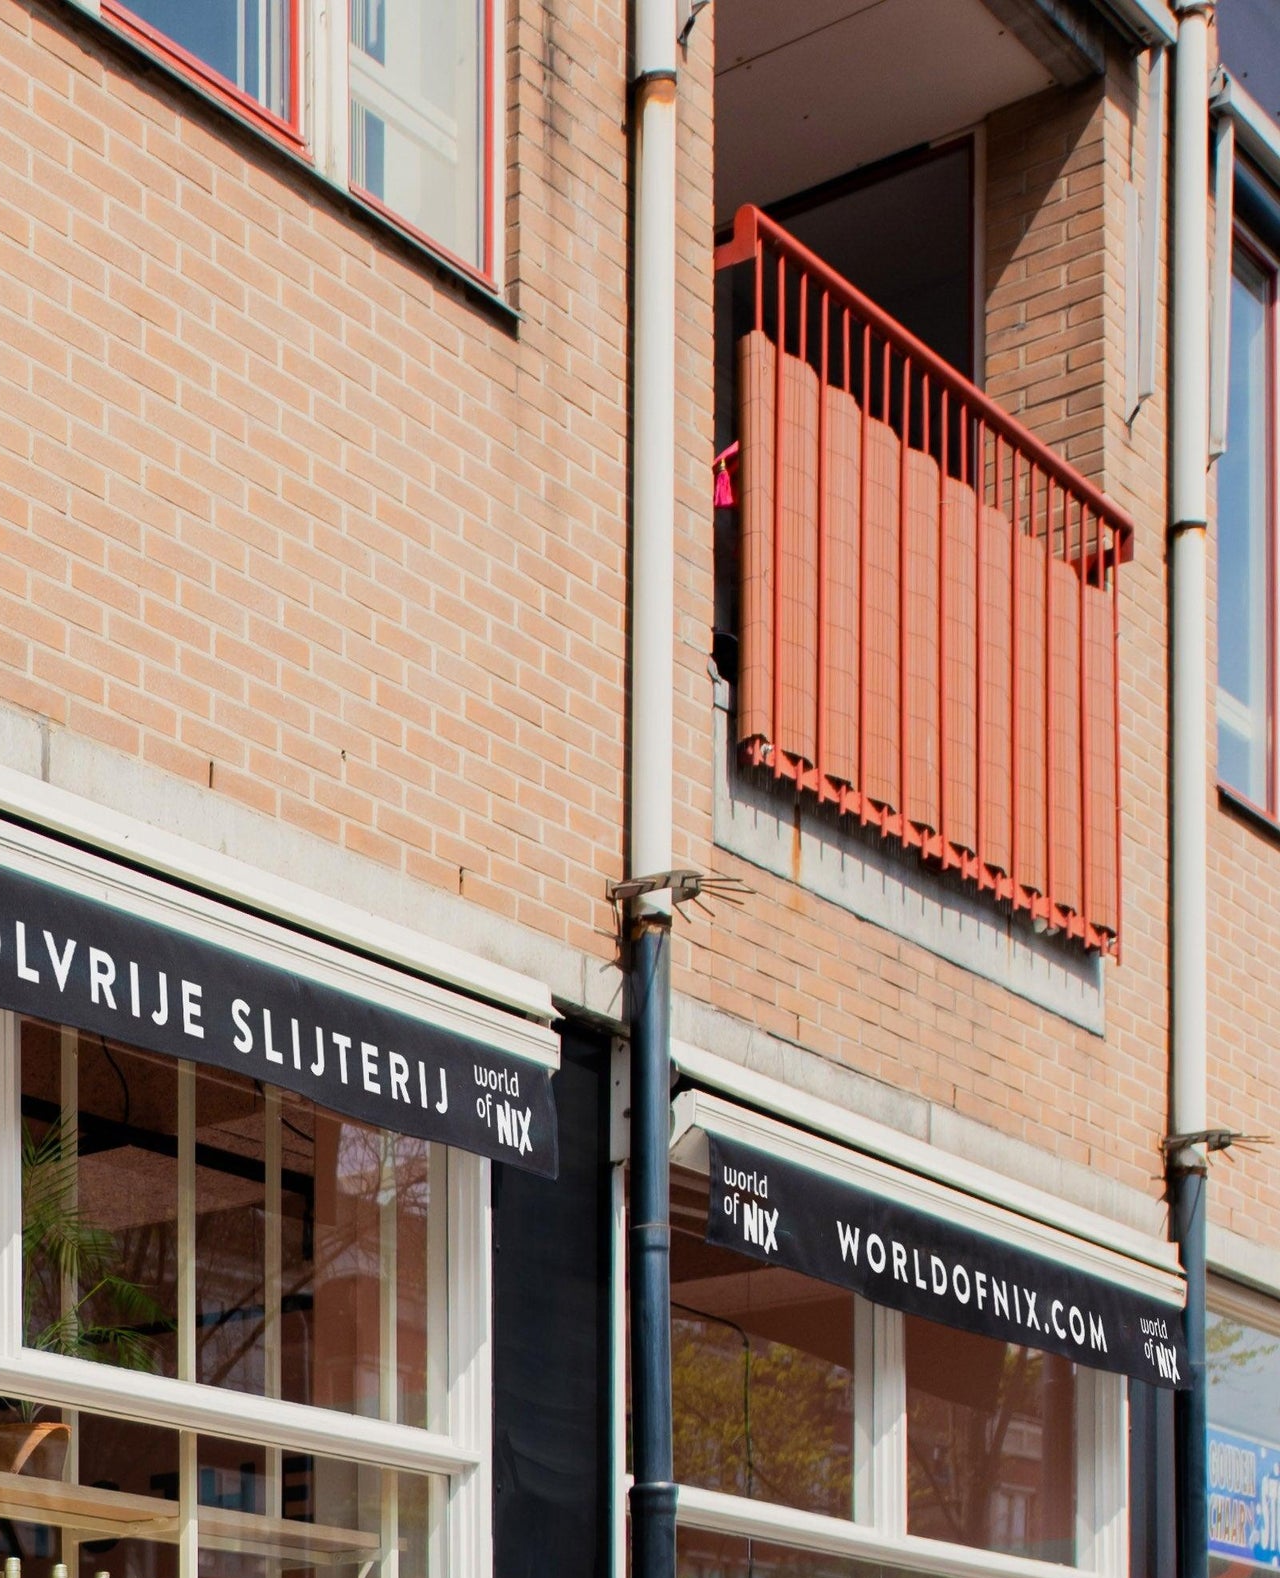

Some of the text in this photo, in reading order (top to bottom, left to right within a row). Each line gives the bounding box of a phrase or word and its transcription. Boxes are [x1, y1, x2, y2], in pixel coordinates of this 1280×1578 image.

[232, 997, 449, 1115] SLIJTERIJ
[474, 1064, 519, 1097] world
[476, 1093, 533, 1156] of NIX
[724, 1165, 768, 1199] world
[724, 1191, 779, 1254] of NIX
[836, 1220, 1108, 1354] WORLDOFNIX.COM
[1140, 1317, 1168, 1339] world
[1144, 1338, 1181, 1384] of NIX
